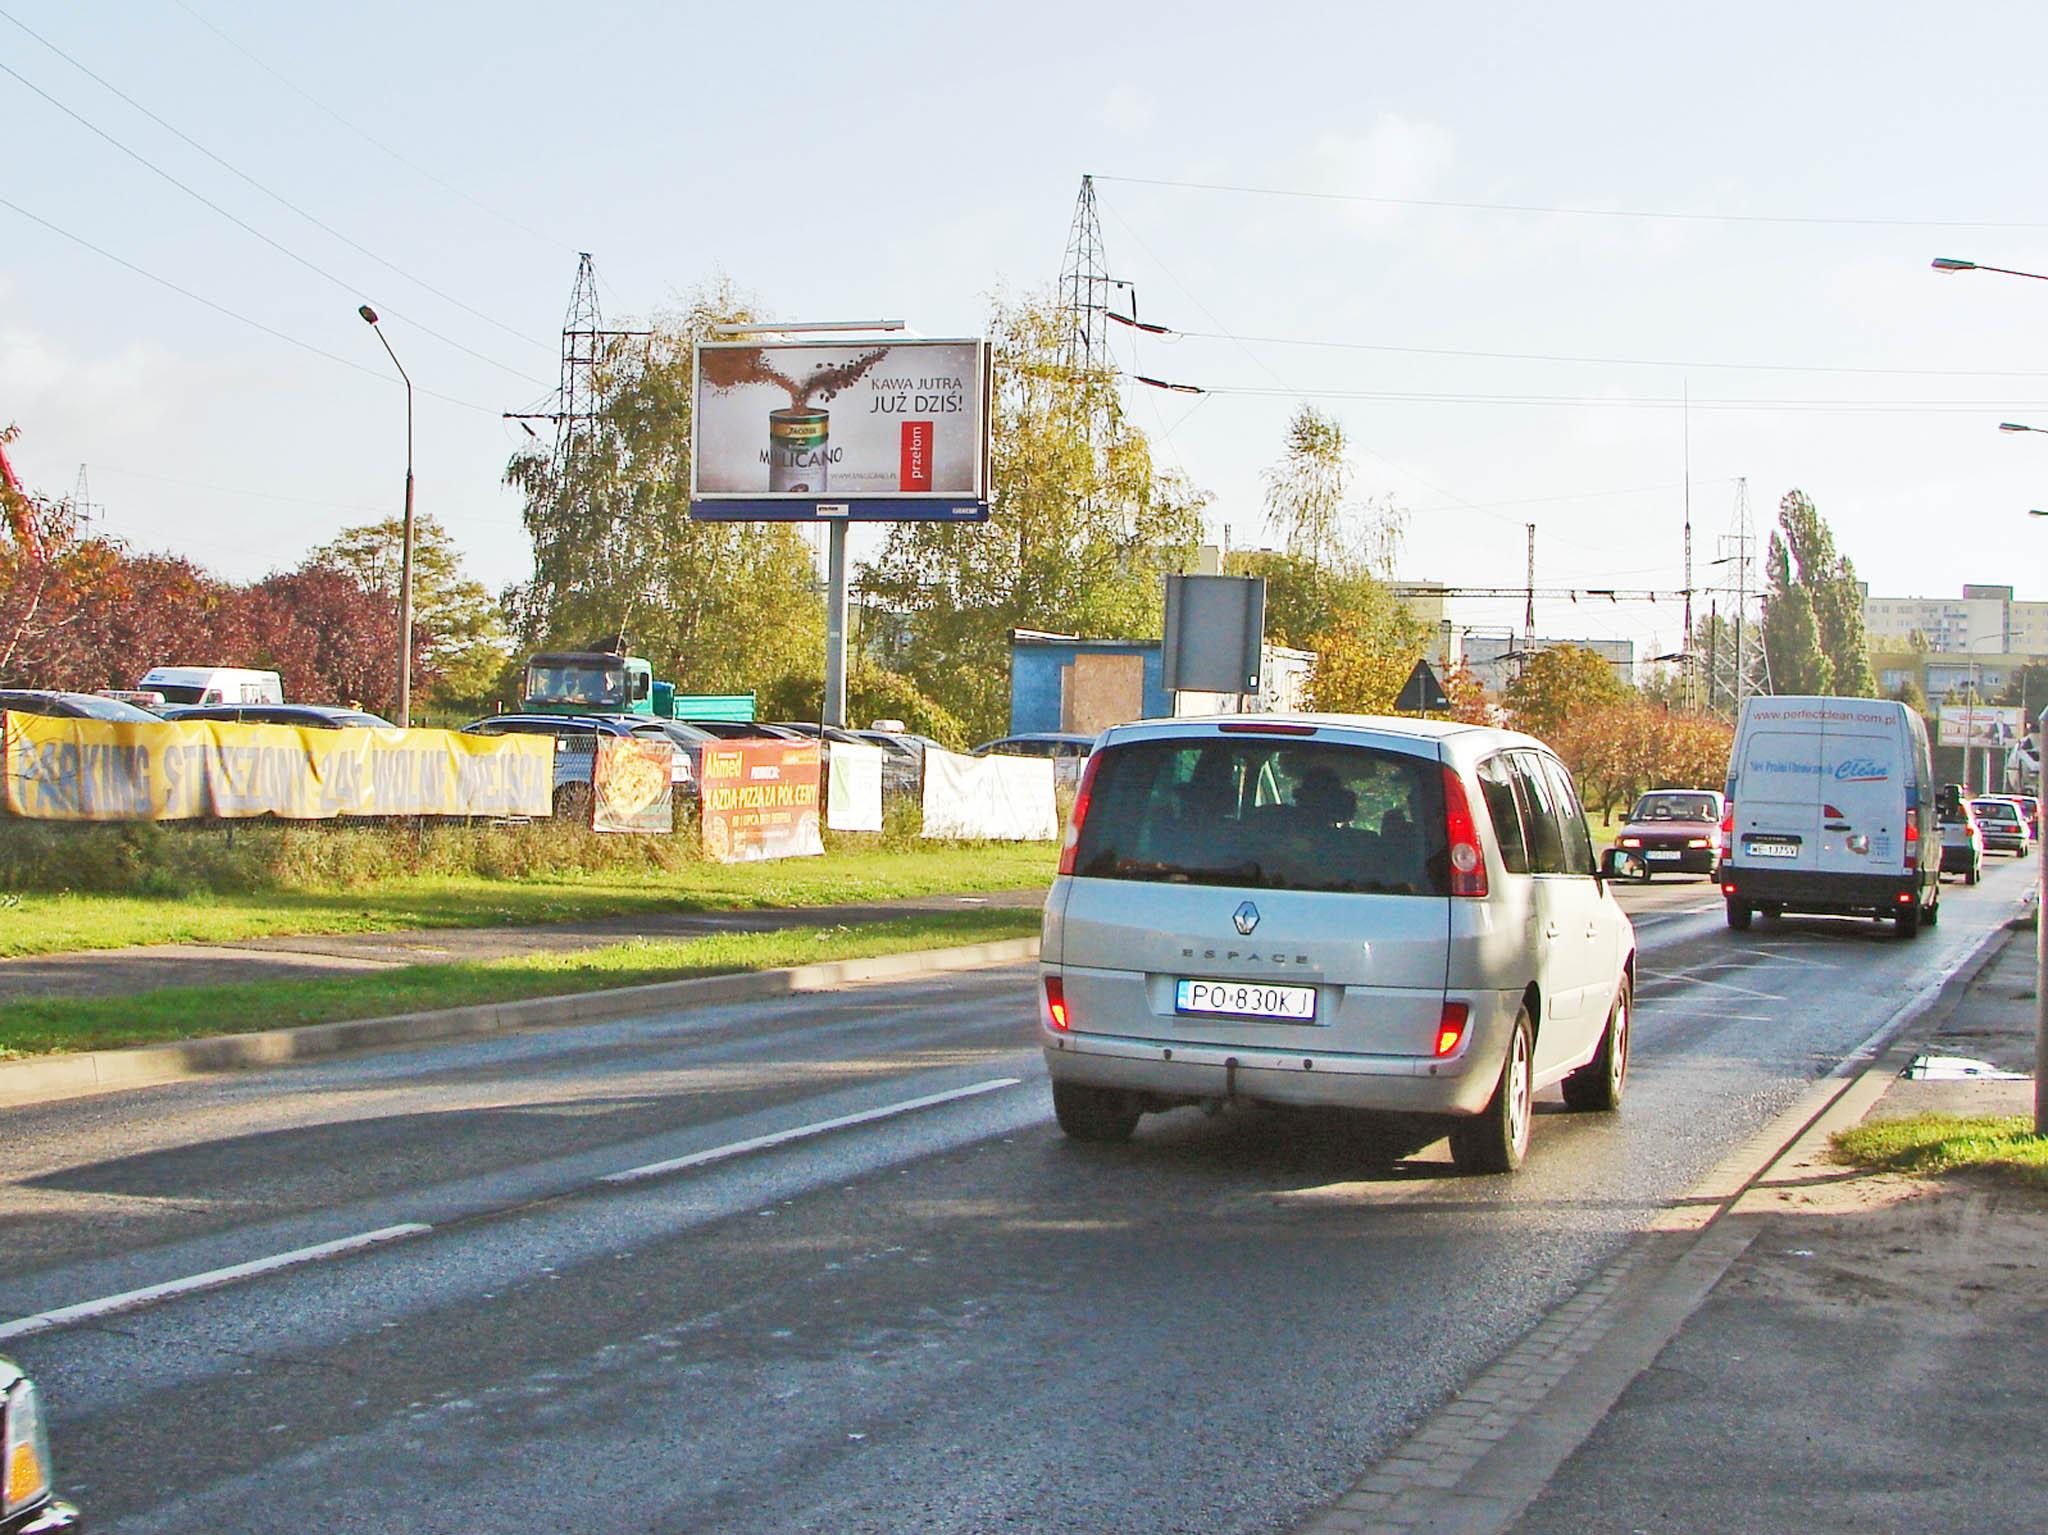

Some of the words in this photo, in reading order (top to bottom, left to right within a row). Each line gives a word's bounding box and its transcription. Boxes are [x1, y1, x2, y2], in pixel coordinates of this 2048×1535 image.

[872, 378, 913, 390] KAWA
[917, 378, 962, 390] JUTRA
[870, 391, 907, 413] JUŻ
[915, 391, 962, 413] DZIŚ!
[759, 447, 843, 468] MLICANO
[910, 426, 923, 479] przełom
[704, 751, 743, 778] Ahmed
[17, 743, 151, 813] PARKING
[704, 782, 737, 812] KAŻDA
[1182, 948, 1308, 964] ESPACE
[1192, 984, 1227, 1008] PO
